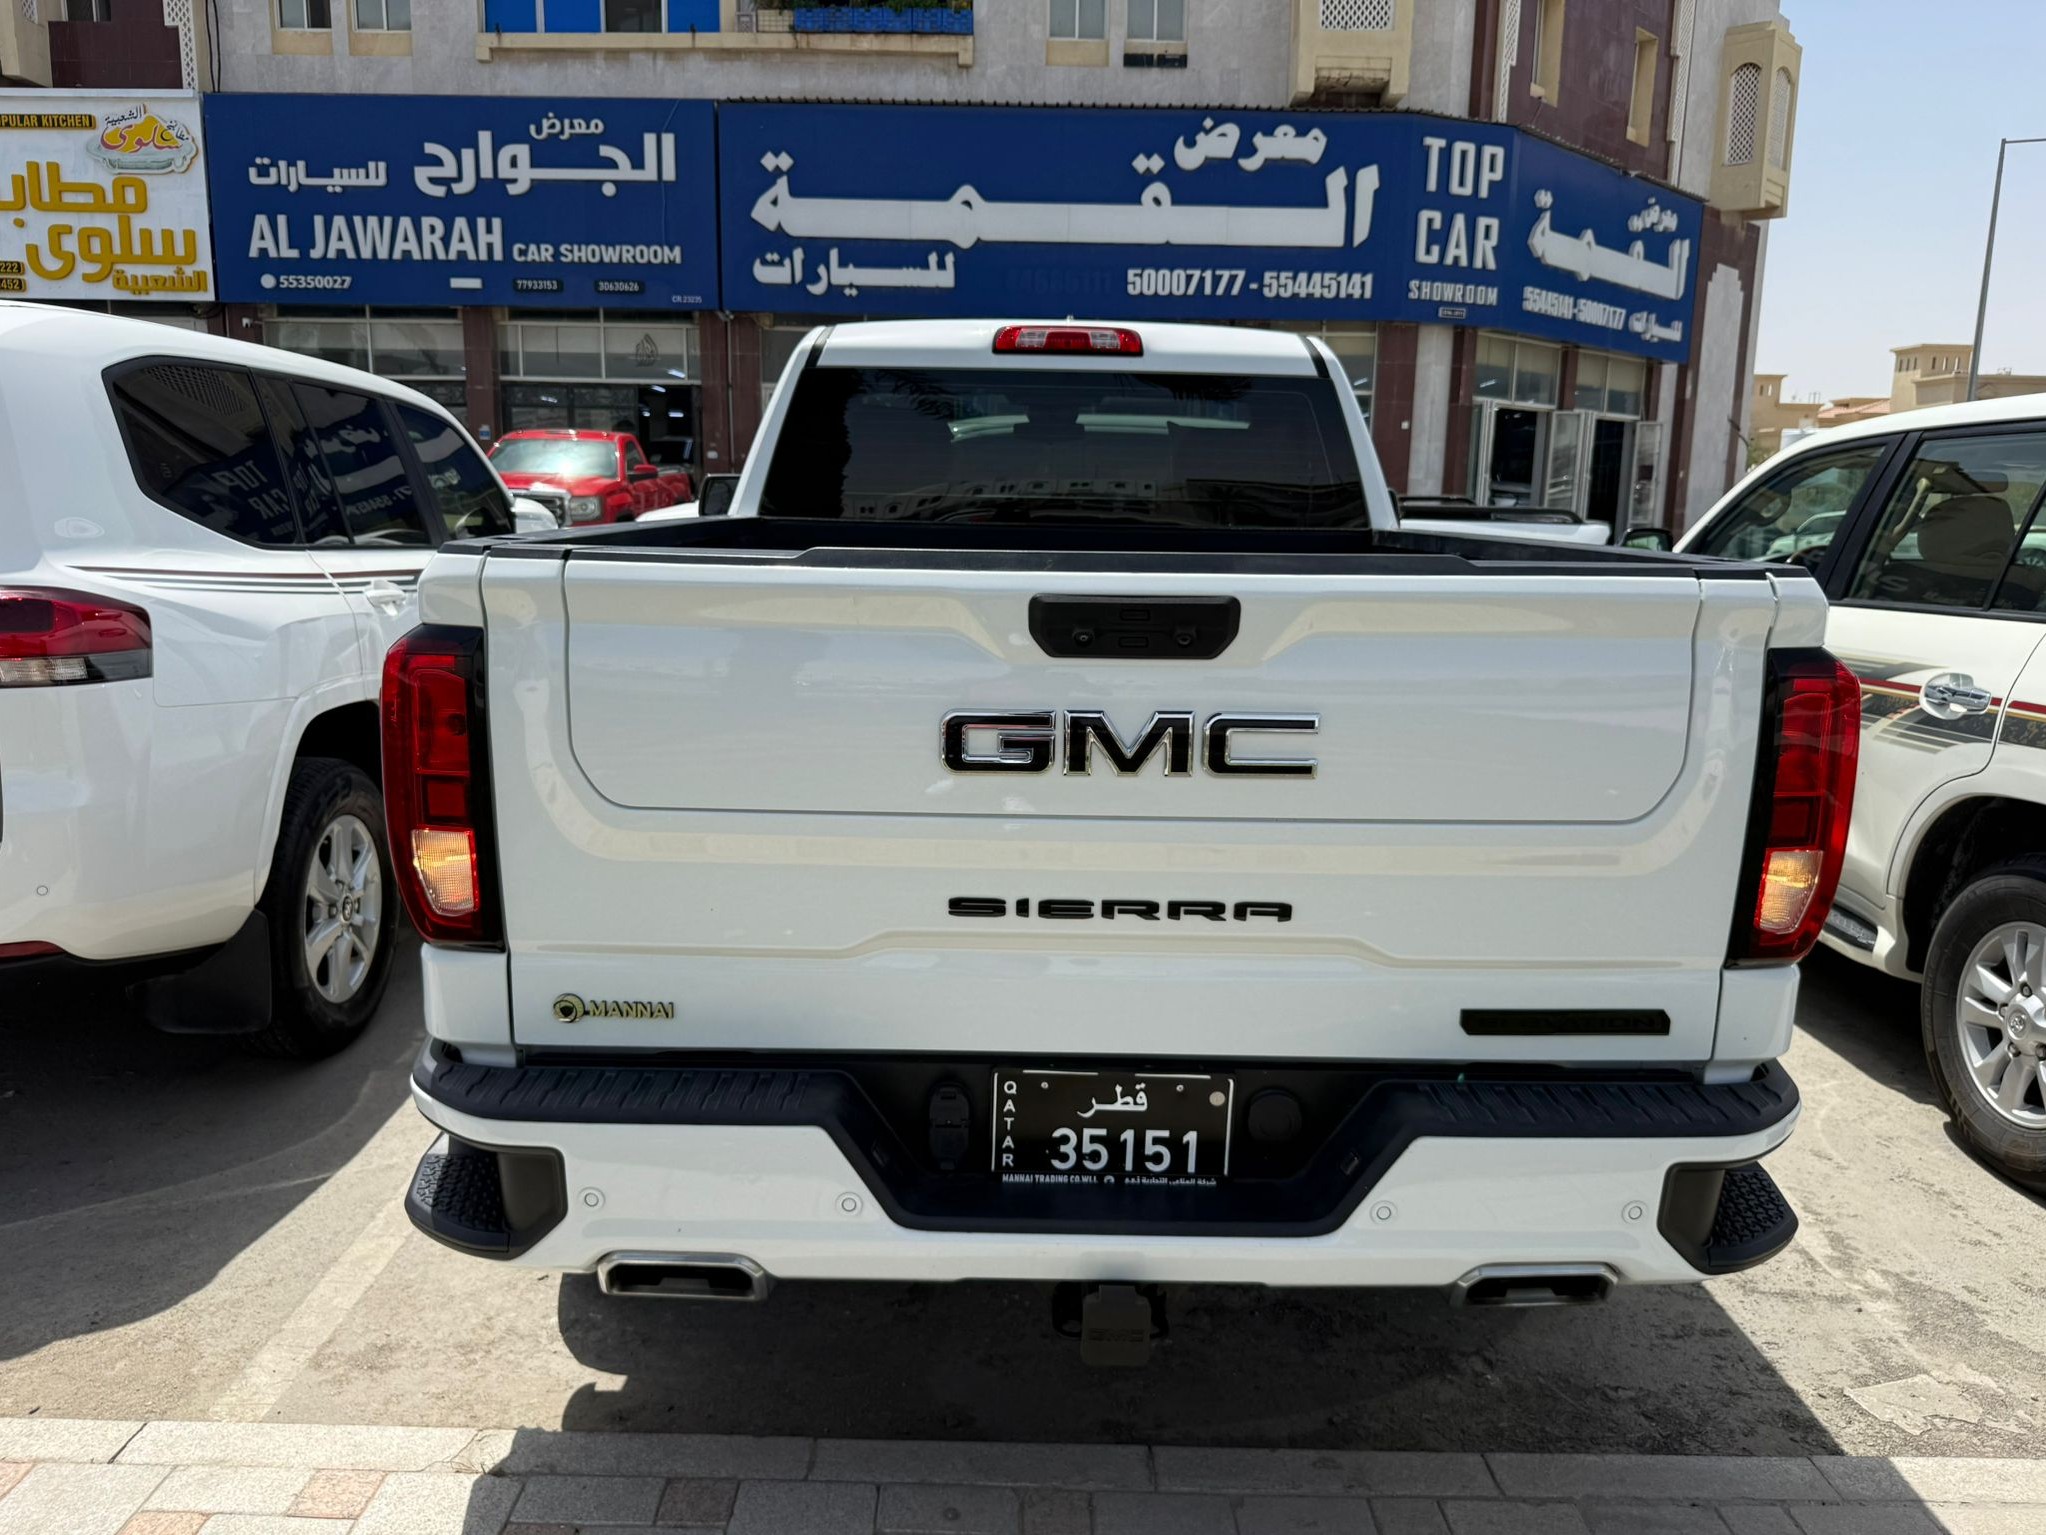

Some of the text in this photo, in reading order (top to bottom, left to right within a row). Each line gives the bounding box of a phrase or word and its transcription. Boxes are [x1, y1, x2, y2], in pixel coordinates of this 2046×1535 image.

[0, 115, 90, 128] PULAR KITCHEN
[104, 104, 144, 126] الشعبية
[529, 112, 605, 140] معرض
[413, 130, 677, 198] الجوارح
[1173, 116, 1328, 172] معرض
[248, 157, 388, 193] للسيارات
[1422, 136, 1505, 199] TOP
[0, 161, 148, 228] مطاب
[750, 151, 1380, 249] القمة
[26, 215, 197, 283] سلوى
[248, 214, 682, 265] AL JAWARAH CAR SHOWROOM
[1414, 209, 1499, 271] CAR
[112, 266, 208, 296] الشعبية
[279, 275, 352, 290] 55350027
[753, 247, 956, 297] للسيارات
[1126, 269, 1247, 297] 50007177
[1262, 271, 1373, 300] 55445141
[1408, 279, 1498, 306] SHOWROOM
[940, 708, 1321, 779] GMC
[948, 896, 1293, 922] SIERRA
[588, 1000, 675, 1019] MANNAI
[1077, 1083, 1149, 1118] قطر
[1002, 1080, 1017, 1167] QATAR
[1050, 1127, 1198, 1173] 35151
[1002, 1174, 1033, 1184] MANNAI
[1034, 1174, 1069, 1184] TRADING
